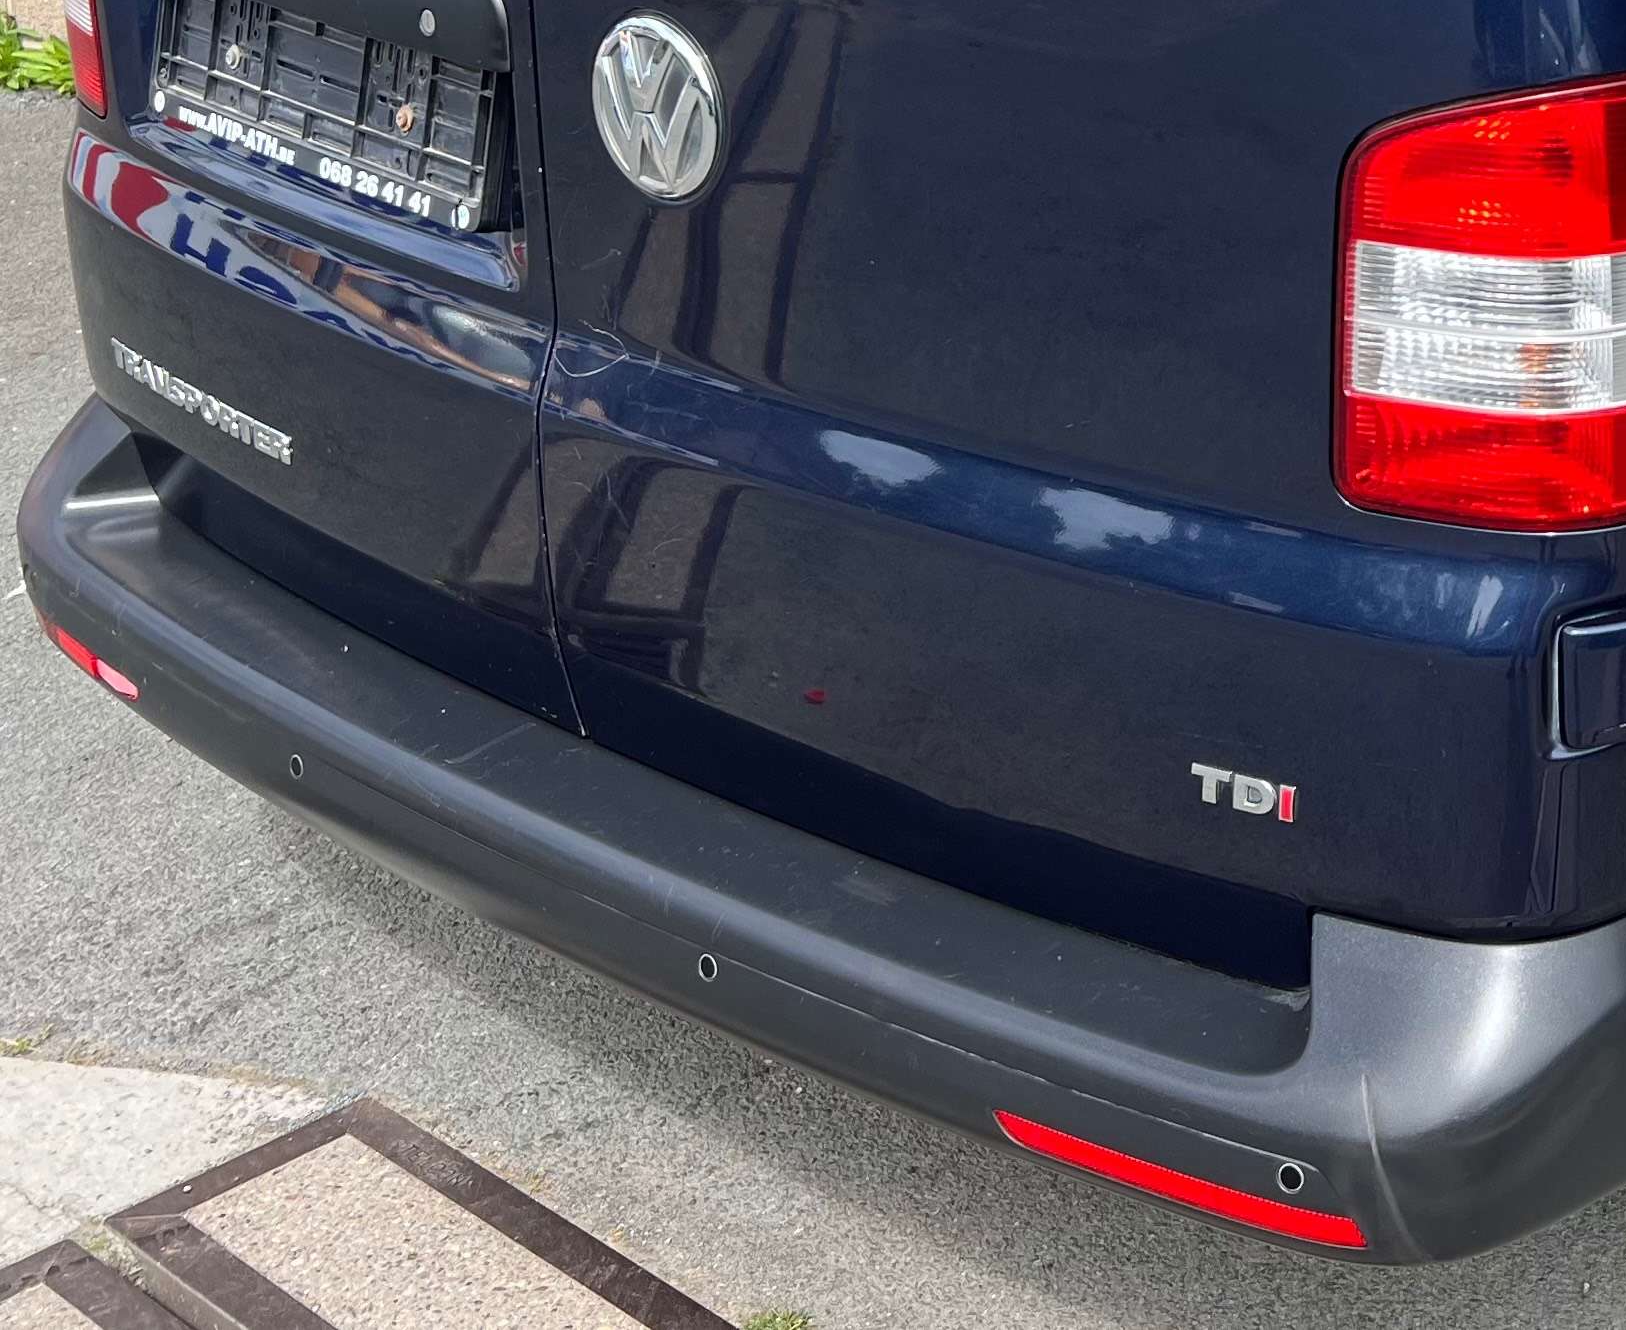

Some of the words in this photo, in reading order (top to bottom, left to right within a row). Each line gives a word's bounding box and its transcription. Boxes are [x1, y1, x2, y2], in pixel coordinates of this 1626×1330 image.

[319, 157, 353, 187] 068
[355, 170, 380, 197] 26
[381, 181, 404, 207] 41
[408, 191, 431, 218] 41
[111, 336, 294, 467] TRANSPORTER
[1191, 761, 1297, 823] TDI
